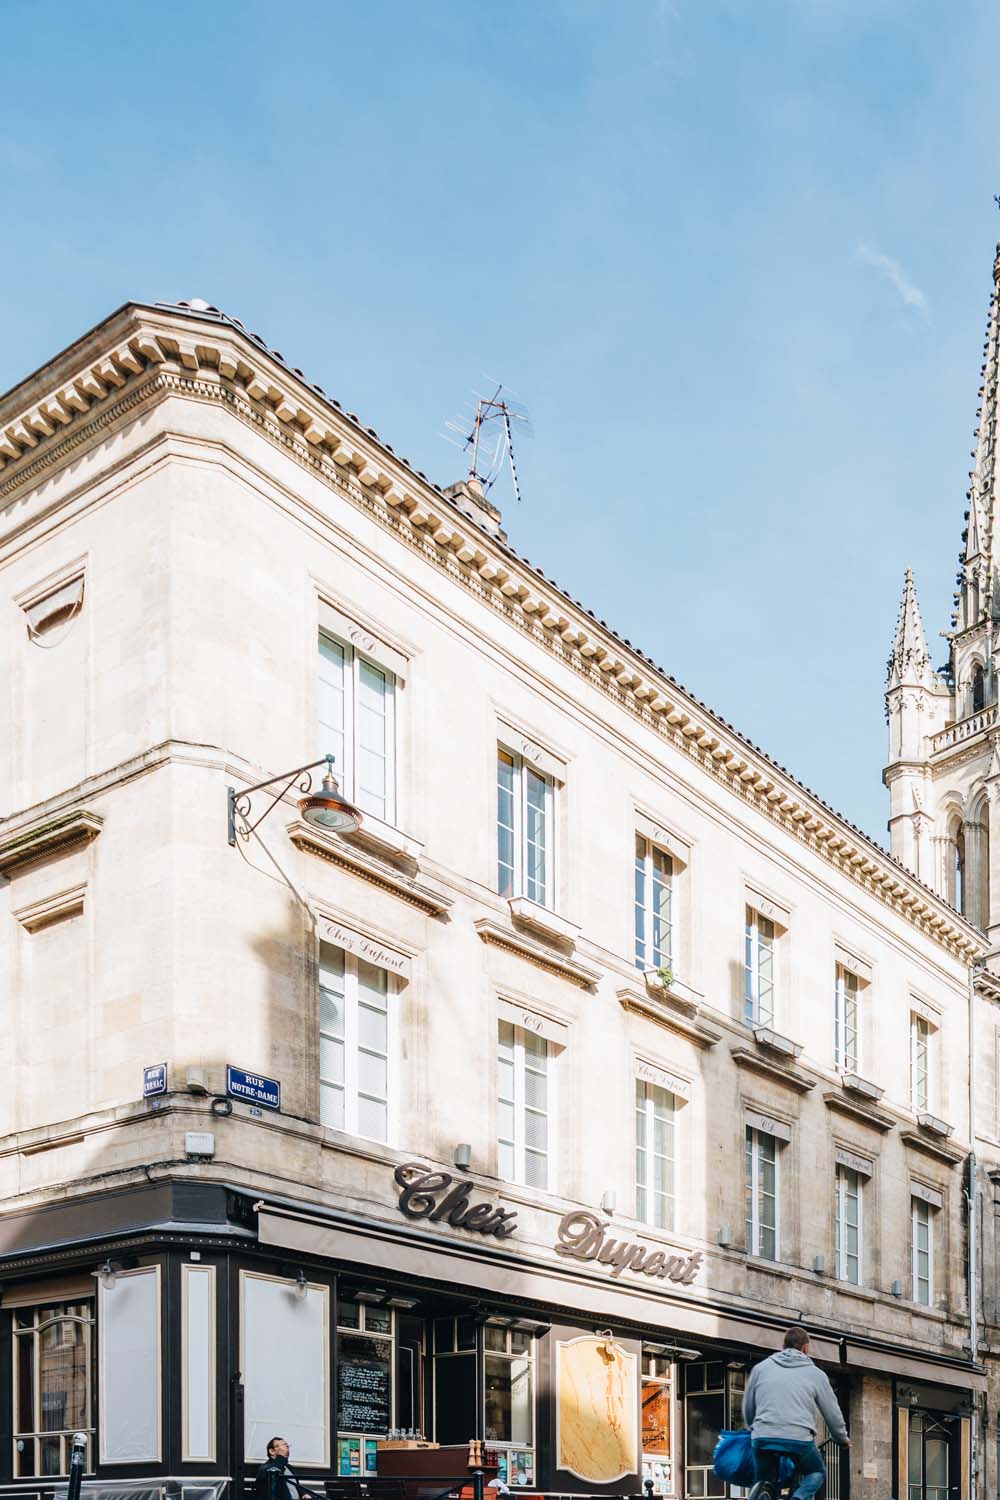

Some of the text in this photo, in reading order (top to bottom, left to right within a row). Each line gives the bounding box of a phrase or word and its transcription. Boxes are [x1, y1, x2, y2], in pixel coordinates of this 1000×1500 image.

[324, 923, 404, 969] Chez Dupont
[231, 1081, 278, 1104] NOTRE-DAME
[245, 1075, 265, 1088] RUE
[394, 1162, 704, 1285] Chez Dupont
